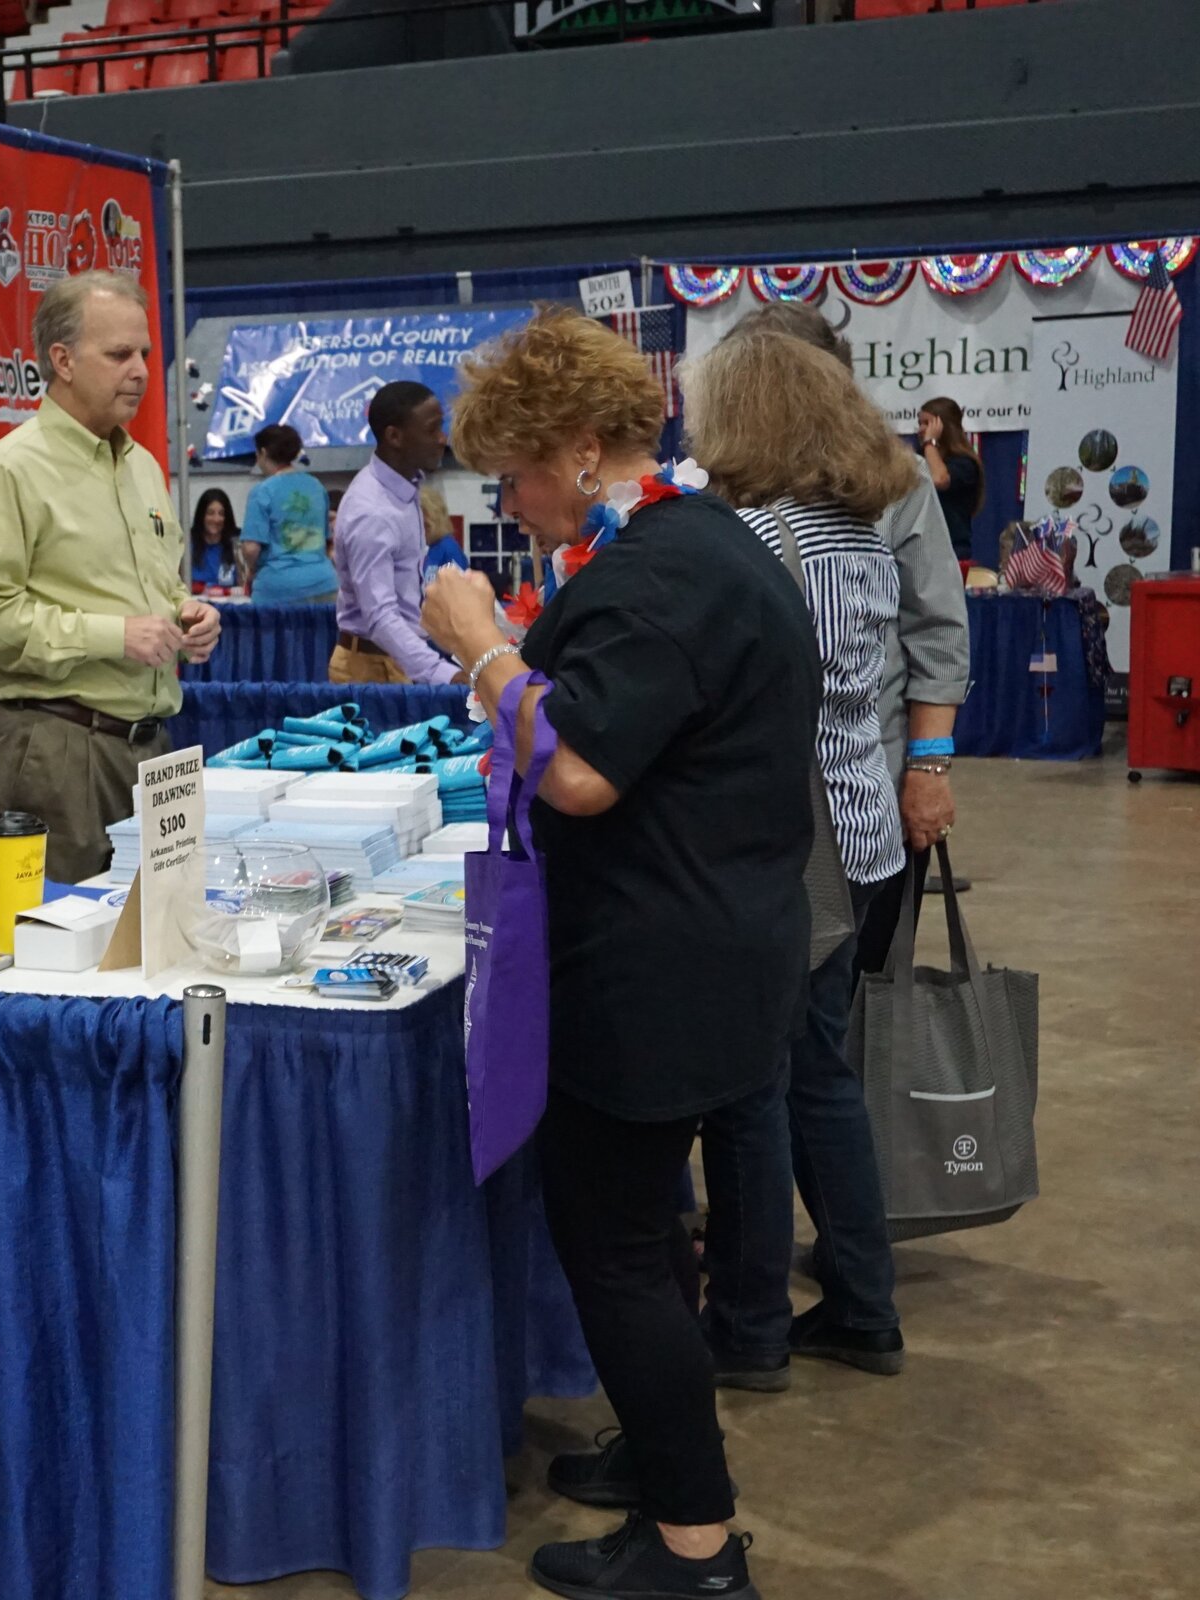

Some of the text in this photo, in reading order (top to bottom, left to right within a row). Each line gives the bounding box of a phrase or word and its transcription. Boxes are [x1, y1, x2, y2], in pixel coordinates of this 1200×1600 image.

[588, 276, 620, 294] BOOTH
[588, 293, 625, 314] 502
[391, 327, 473, 346] COUNTY
[368, 350, 395, 367] OF
[402, 349, 485, 367] REALTO
[851, 336, 1031, 391] Highlan
[1073, 364, 1156, 390] Highland
[987, 407, 1014, 419] our
[144, 759, 200, 787] GRAND PRIZE
[152, 782, 197, 808] DRAWING!!
[160, 812, 186, 839] $100
[175, 836, 197, 850] Printing
[944, 1160, 984, 1176] Tyson
